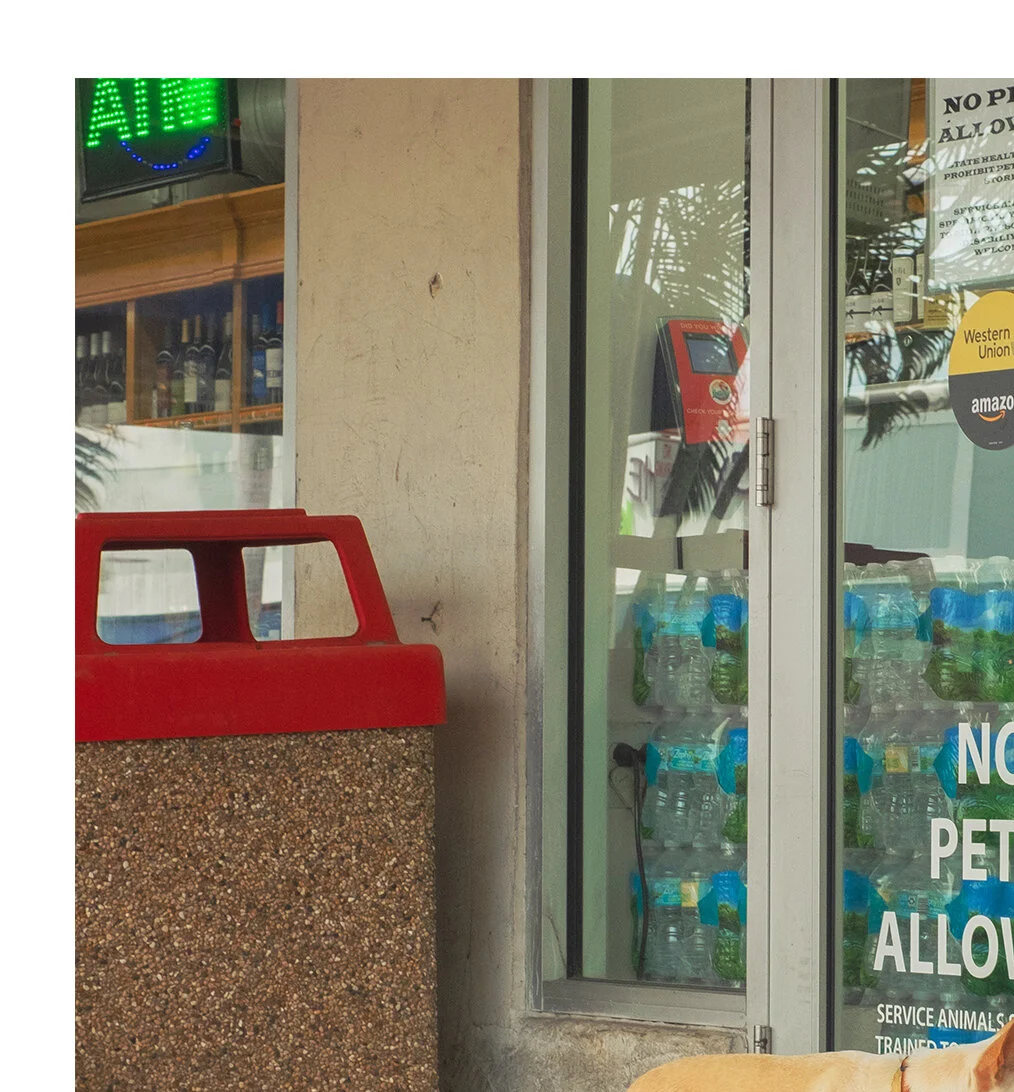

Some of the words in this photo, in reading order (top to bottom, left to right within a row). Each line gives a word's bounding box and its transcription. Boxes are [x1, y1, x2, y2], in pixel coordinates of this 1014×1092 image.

[943, 93, 982, 115] NO
[947, 157, 981, 170] TATE
[943, 165, 996, 181] PROHIBIT
[963, 328, 1011, 344] Western
[978, 343, 1011, 359] Union
[876, 1003, 934, 1029] SERVICE
[937, 1008, 1004, 1033] ANIMALS
